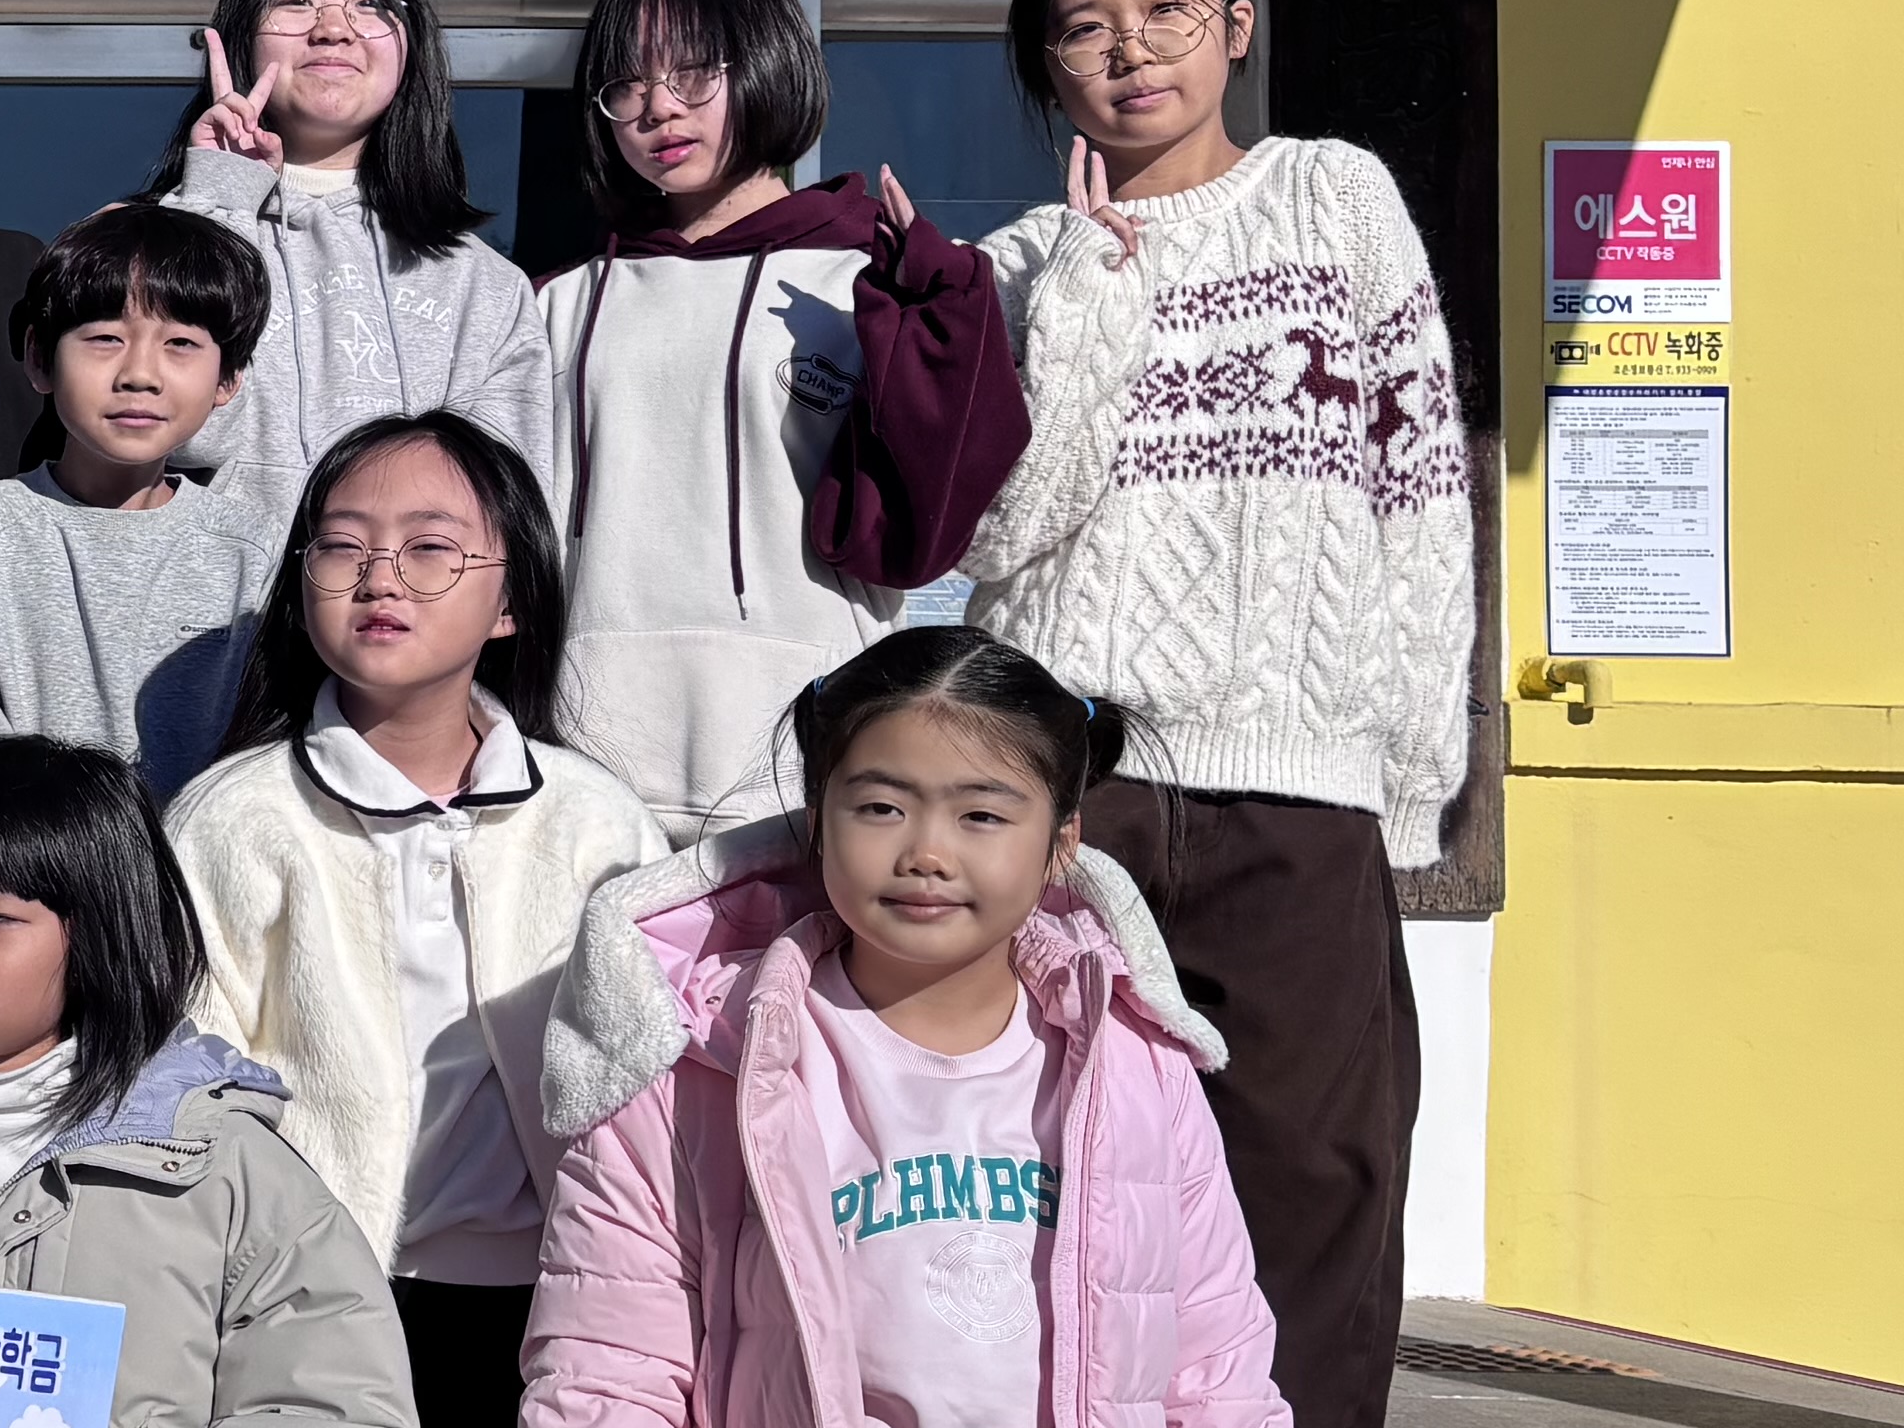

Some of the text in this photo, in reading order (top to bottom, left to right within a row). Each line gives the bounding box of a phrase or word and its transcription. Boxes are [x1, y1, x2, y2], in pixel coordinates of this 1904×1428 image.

[1694, 156, 1716, 169] 안심
[1574, 192, 1697, 240] 에스원
[1596, 246, 1675, 261] CCTV 작동중
[1553, 294, 1633, 314] SECOM
[1607, 331, 1724, 361] CCTV 녹화중
